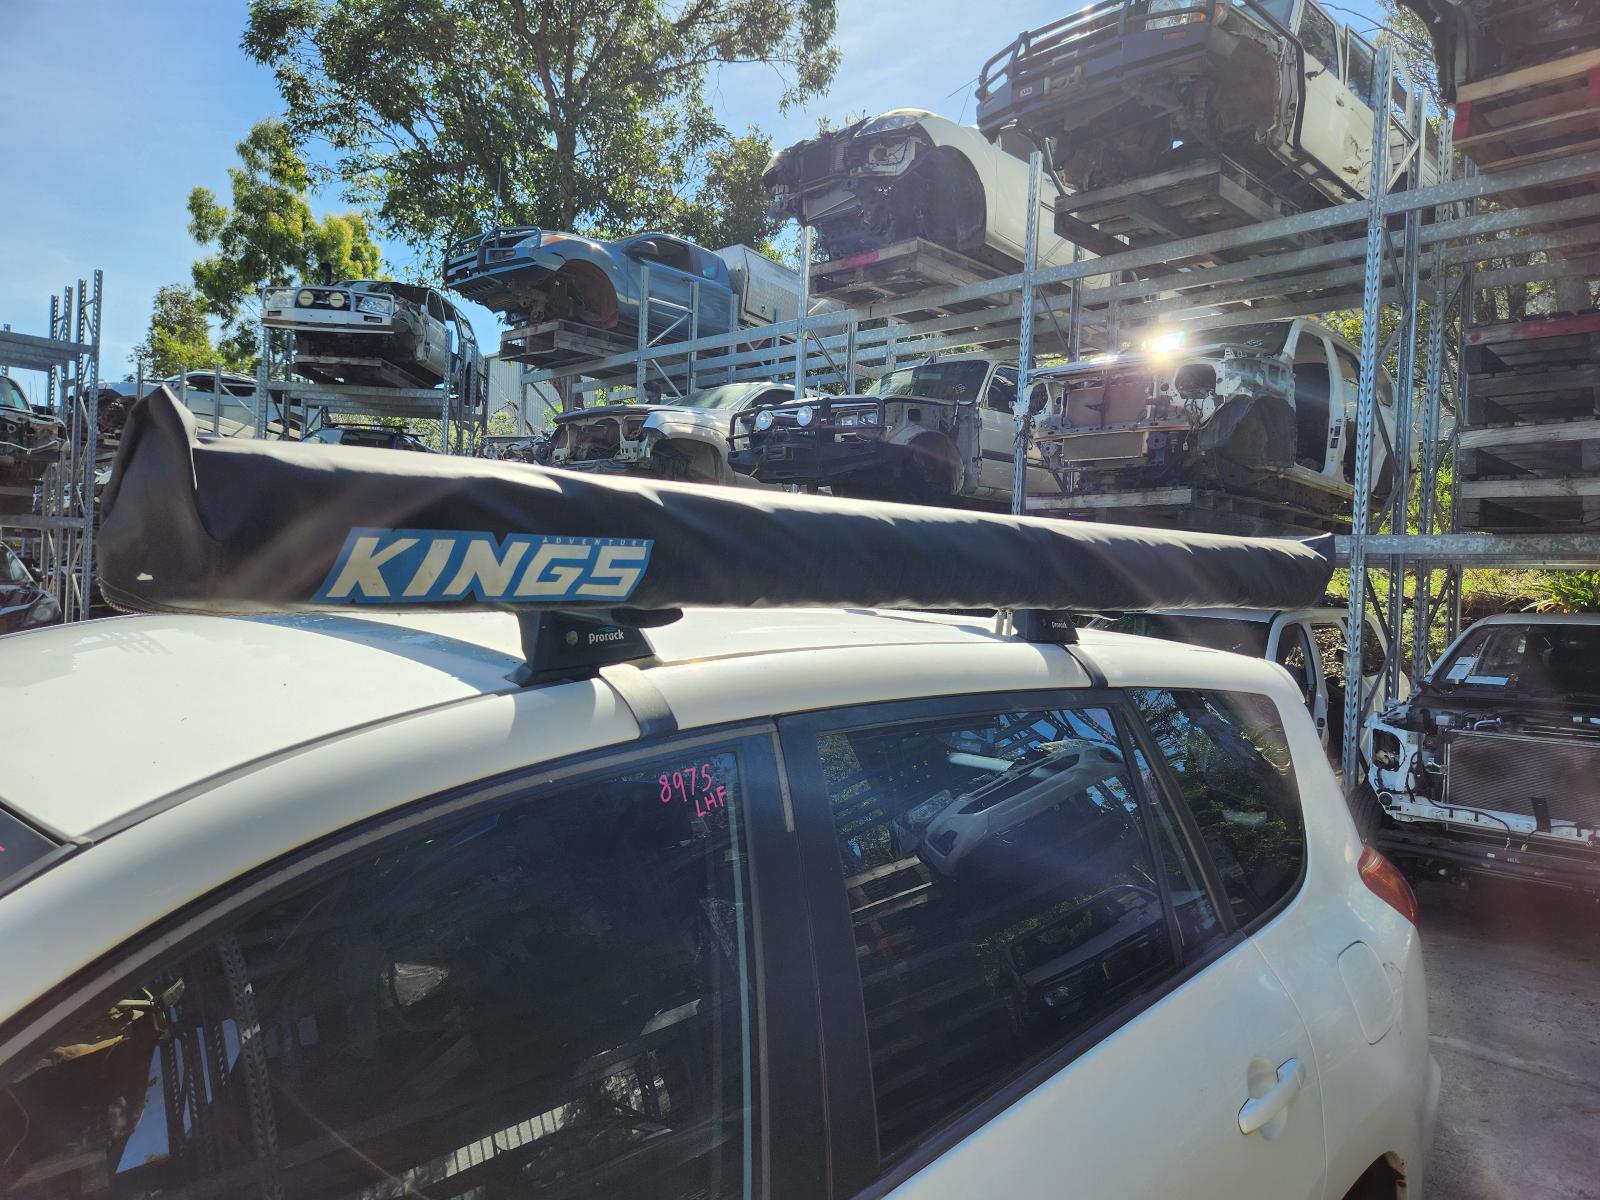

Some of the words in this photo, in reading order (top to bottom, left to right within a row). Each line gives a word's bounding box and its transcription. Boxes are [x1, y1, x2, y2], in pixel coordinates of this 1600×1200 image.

[542, 535, 649, 547] ADVENTURE
[326, 537, 648, 598] KINGS
[588, 629, 625, 645] Prorack
[658, 763, 712, 803] 8975
[695, 785, 727, 817] LHF
